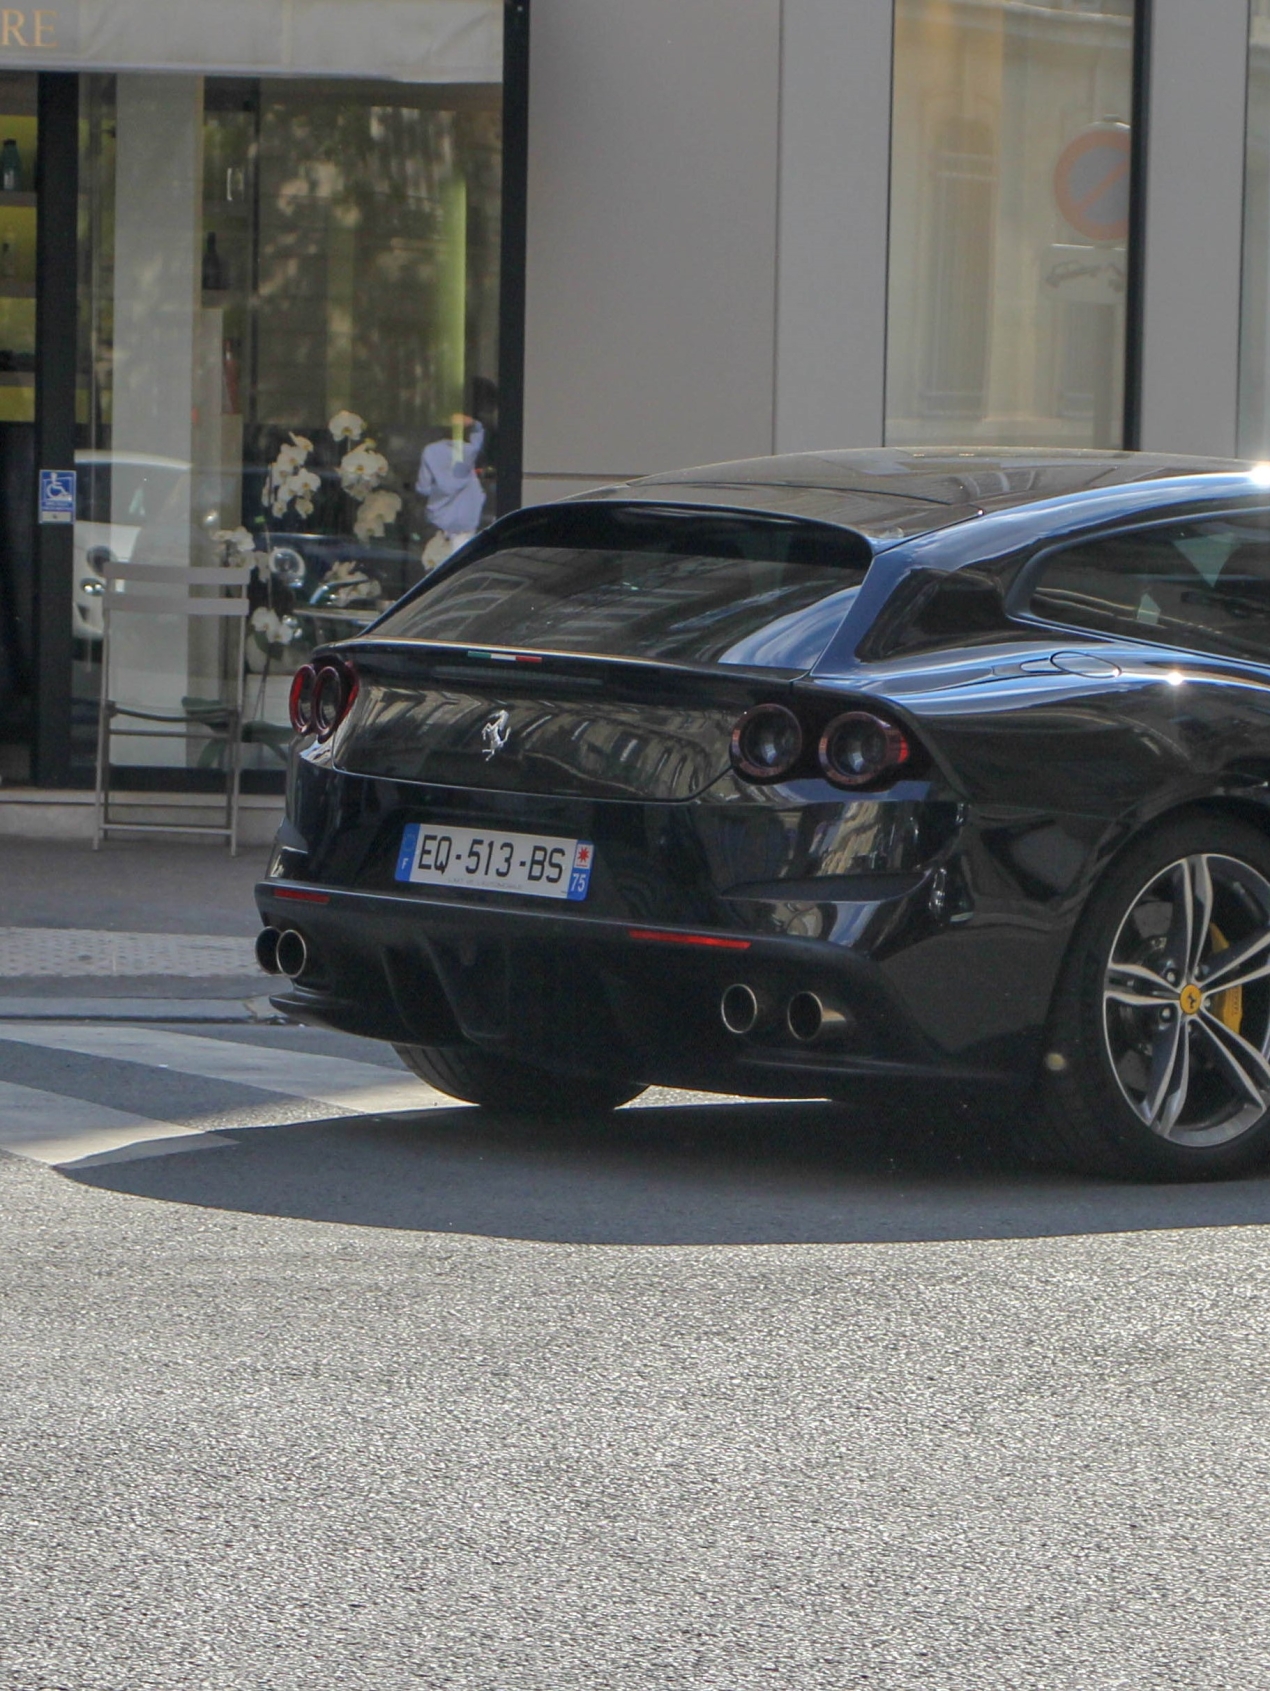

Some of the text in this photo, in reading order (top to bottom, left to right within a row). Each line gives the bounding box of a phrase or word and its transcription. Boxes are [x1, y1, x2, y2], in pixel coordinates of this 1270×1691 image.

[1, 8, 58, 48] RE
[401, 857, 409, 870] F
[418, 834, 566, 884] EQ-513-BS
[570, 872, 587, 893] 75
